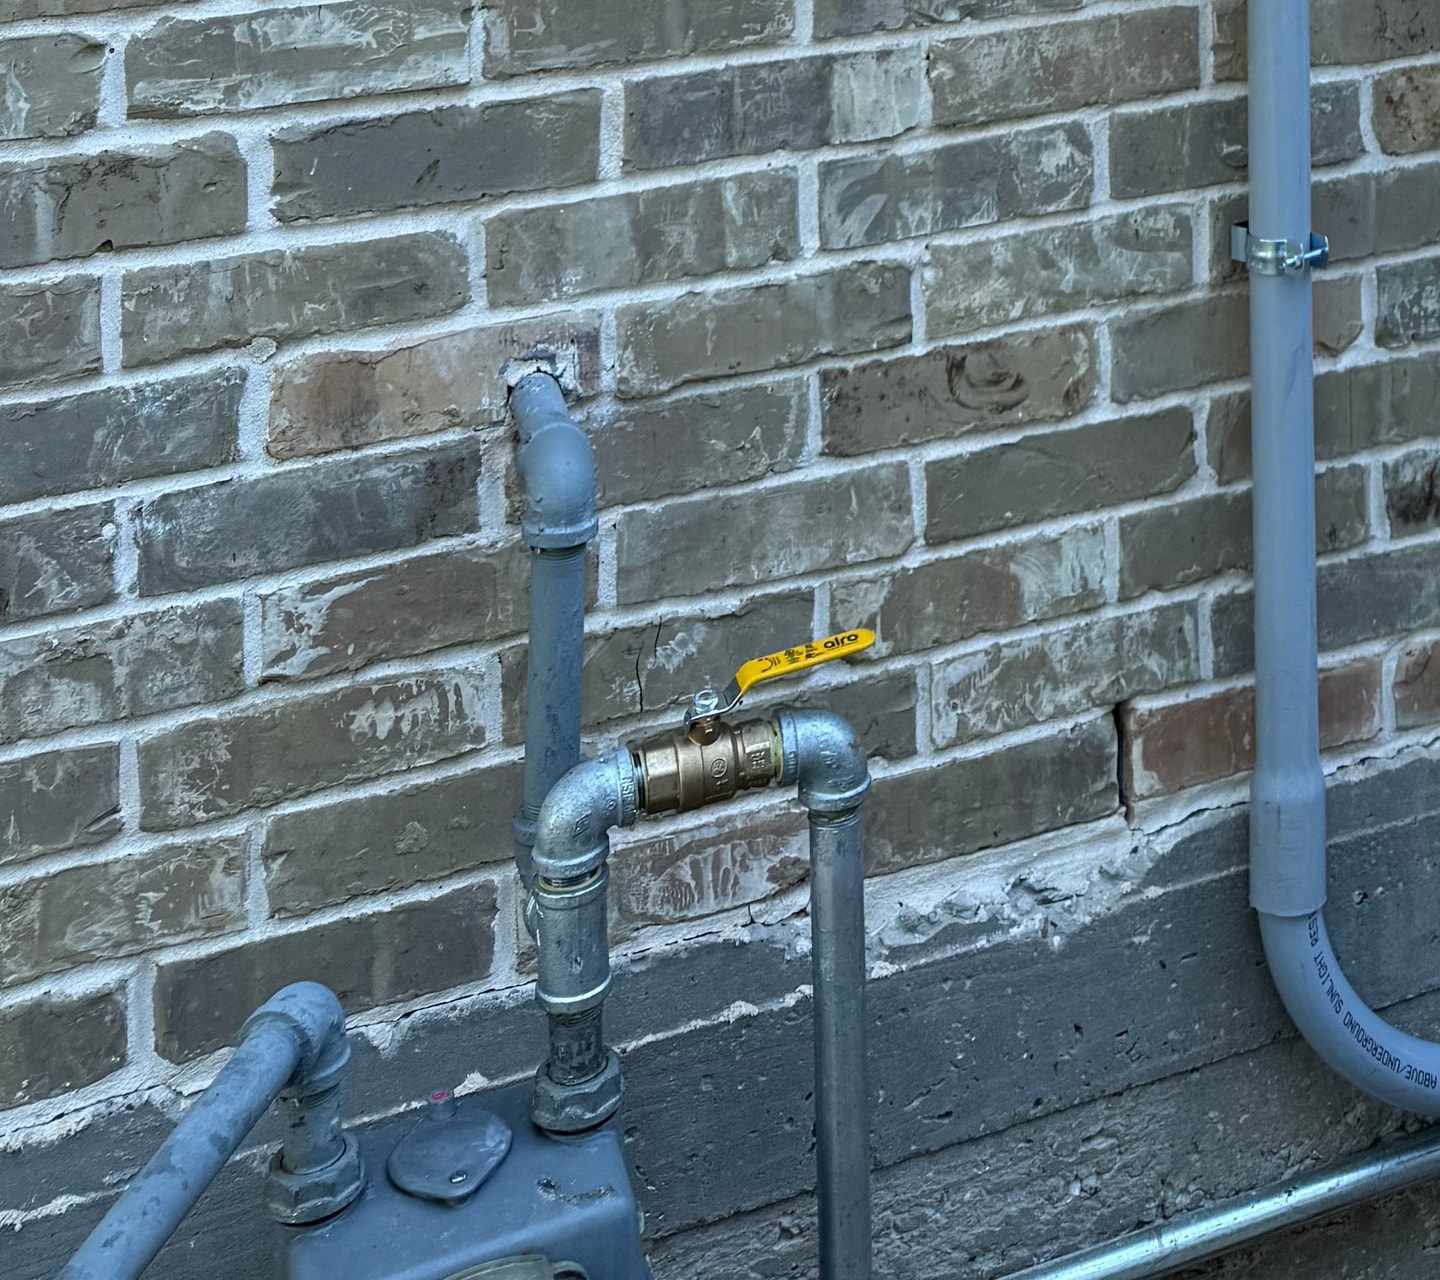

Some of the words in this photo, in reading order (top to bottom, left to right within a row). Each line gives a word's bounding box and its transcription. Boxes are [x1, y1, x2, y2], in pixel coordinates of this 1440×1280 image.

[823, 634, 859, 649] alro
[1313, 950, 1345, 1014] SUNLIGHT
[1342, 1010, 1438, 1090] ABOVE/UNDERGROUND
